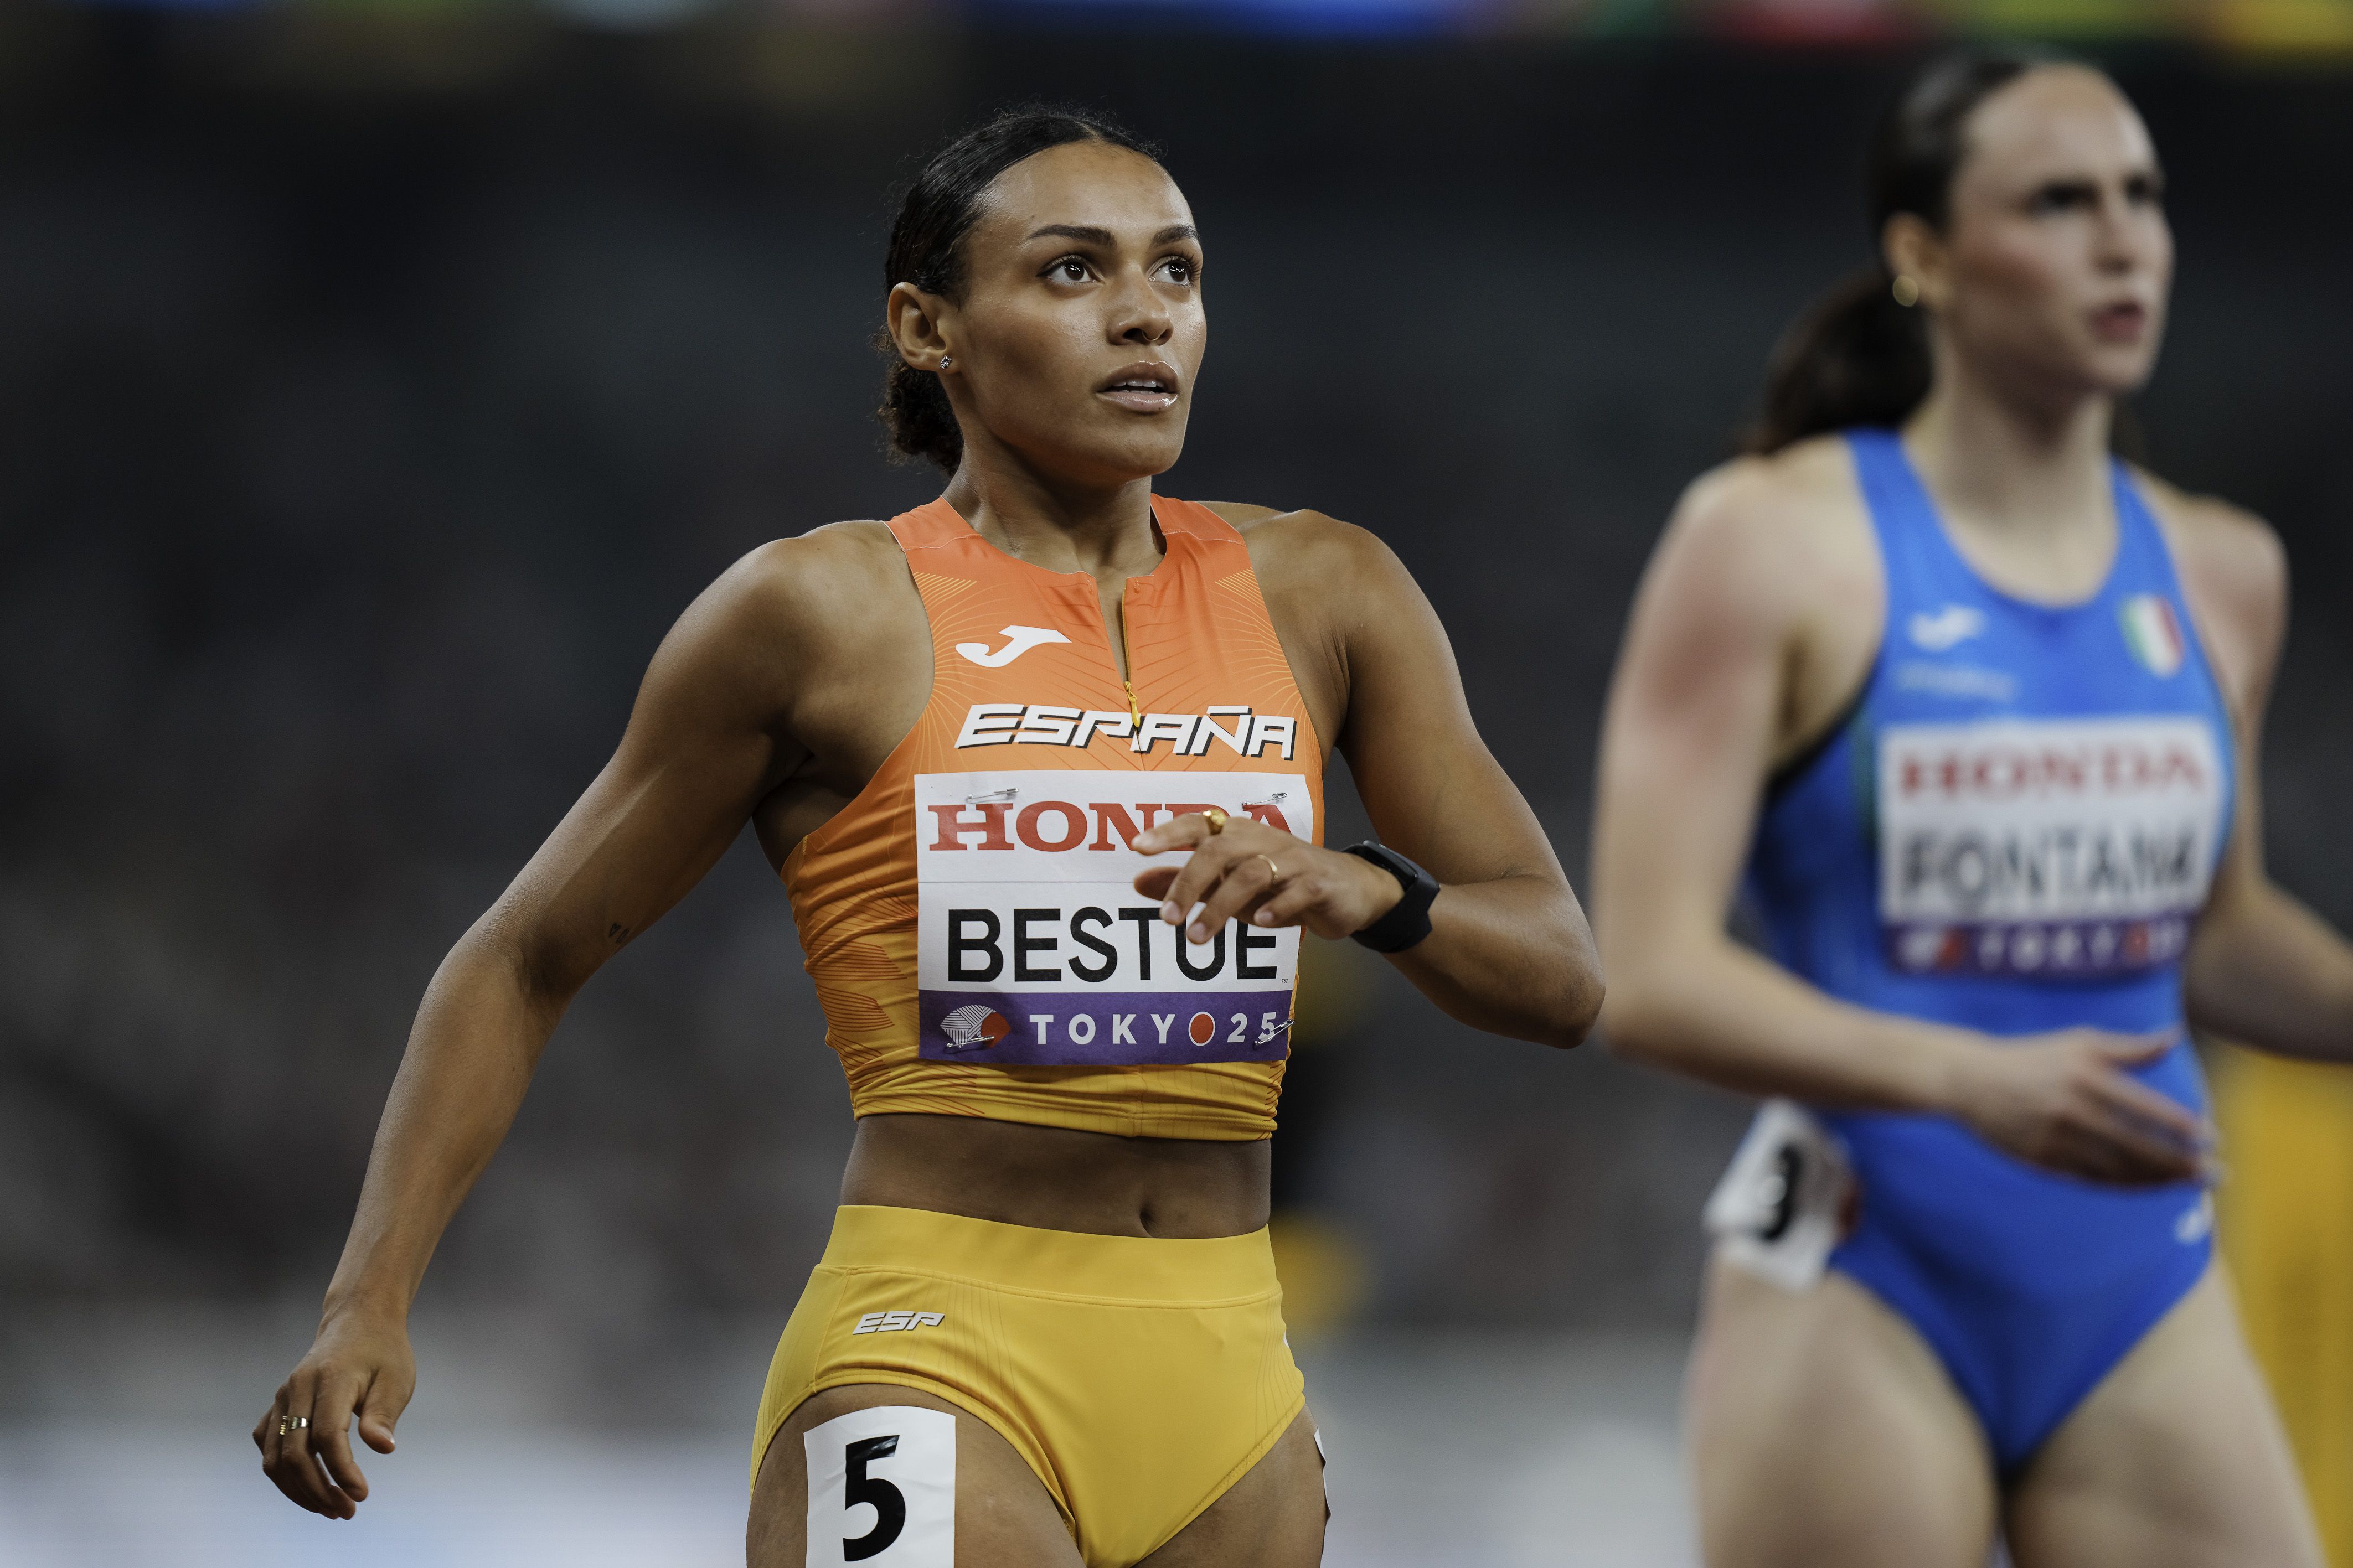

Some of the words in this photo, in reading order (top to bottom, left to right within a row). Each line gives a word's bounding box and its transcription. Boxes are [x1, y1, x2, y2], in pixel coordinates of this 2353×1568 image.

[955, 704, 1297, 761] ESPAÑA
[948, 906, 1278, 982] BESTUE
[852, 1310, 945, 1336] ESP
[842, 1435, 906, 1562] 5
